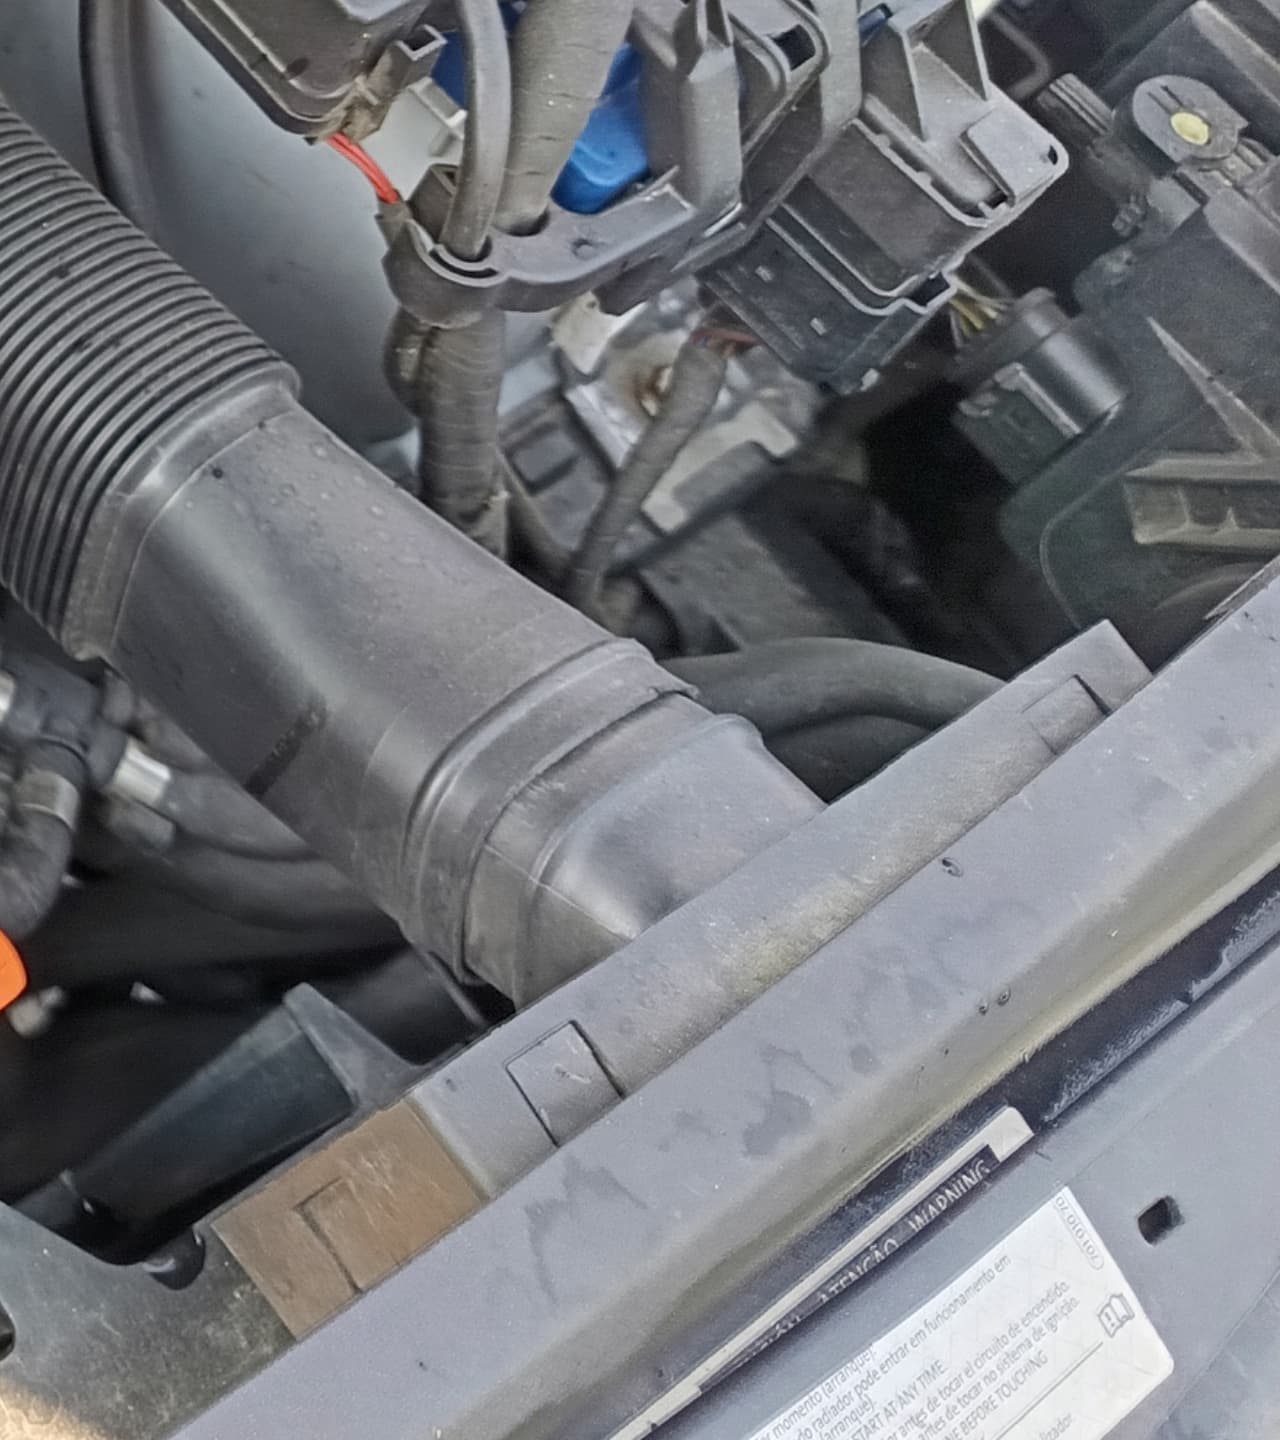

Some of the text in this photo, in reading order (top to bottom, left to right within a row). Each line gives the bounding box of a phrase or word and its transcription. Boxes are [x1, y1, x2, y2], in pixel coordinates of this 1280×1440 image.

[809, 1390, 854, 1431] radiador
[850, 1367, 882, 1396] pode
[877, 1343, 910, 1373] entrar
[908, 1329, 926, 1347] em
[993, 1255, 1011, 1272] em
[897, 1408, 928, 1436] antes
[924, 1395, 940, 1411] de
[937, 1373, 965, 1399] tocar
[971, 1334, 1009, 1369] circuito
[1005, 1322, 1022, 1339] de
[943, 1404, 959, 1419] de
[956, 1382, 984, 1407] tocar
[994, 1337, 1033, 1373] sistema
[1030, 1326, 1046, 1342] de
[880, 1401, 899, 1419] AT
[895, 1381, 921, 1406] ANY
[957, 1351, 1049, 1434] BEFORE TOUCHING
